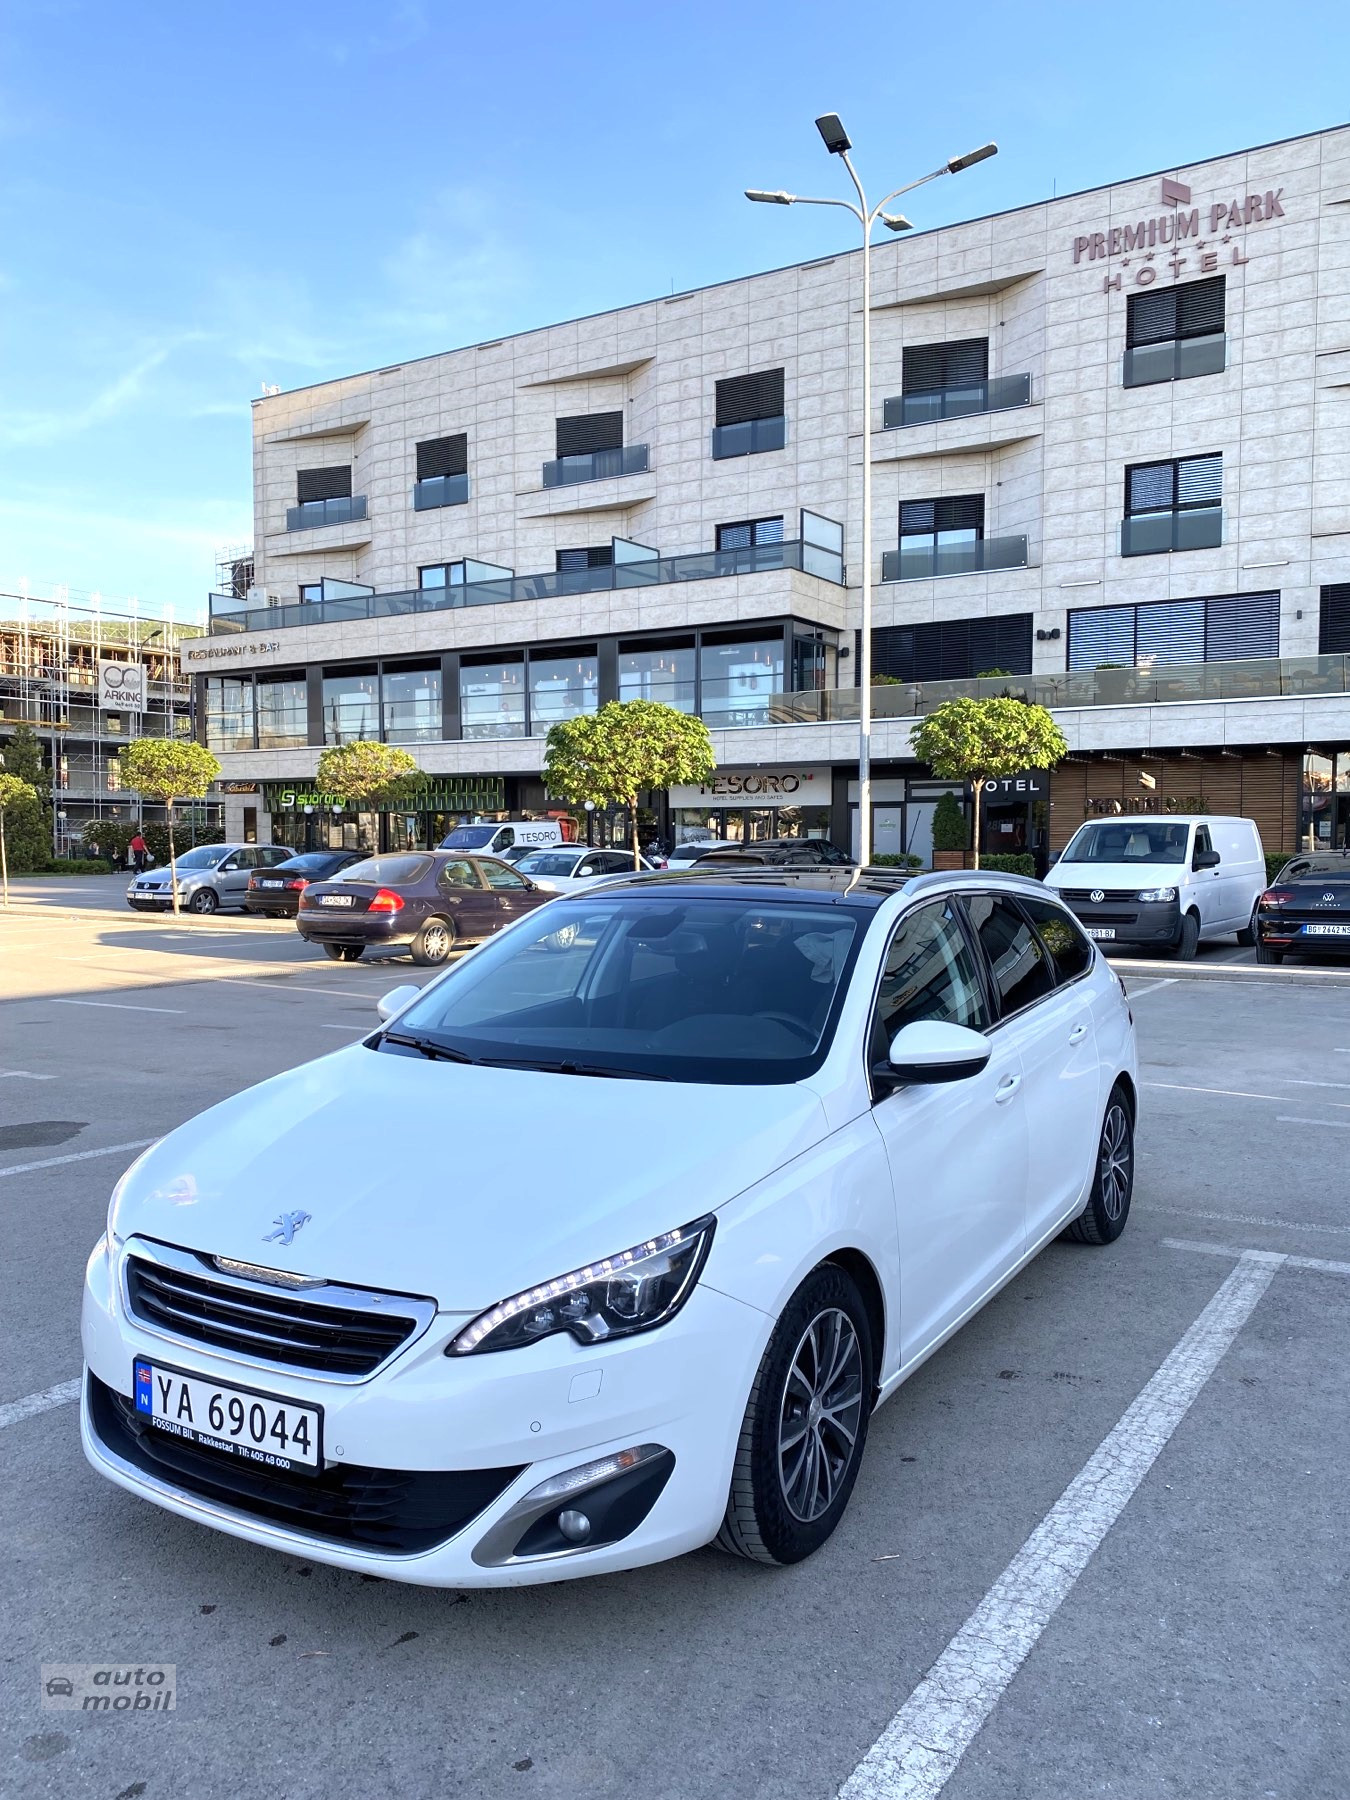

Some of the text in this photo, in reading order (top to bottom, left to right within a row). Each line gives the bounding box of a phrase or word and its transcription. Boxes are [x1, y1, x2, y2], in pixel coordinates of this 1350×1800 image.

[1073, 187, 1286, 264] PREMIUM PARK
[1103, 246, 1250, 294] HOTEL
[260, 641, 280, 654] BAR
[970, 779, 1040, 792] OTEL
[1084, 797, 1160, 814] PREMIUM
[520, 831, 556, 843] TESORO
[141, 1393, 148, 1406] N
[157, 1375, 312, 1456] YA 69044
[152, 1416, 182, 1436] FOSSUM
[182, 1429, 195, 1440] BIL
[198, 1434, 234, 1453] Rakkestad
[250, 1450, 264, 1462] 405
[265, 1455, 275, 1465] 48
[275, 1458, 291, 1470] 000
